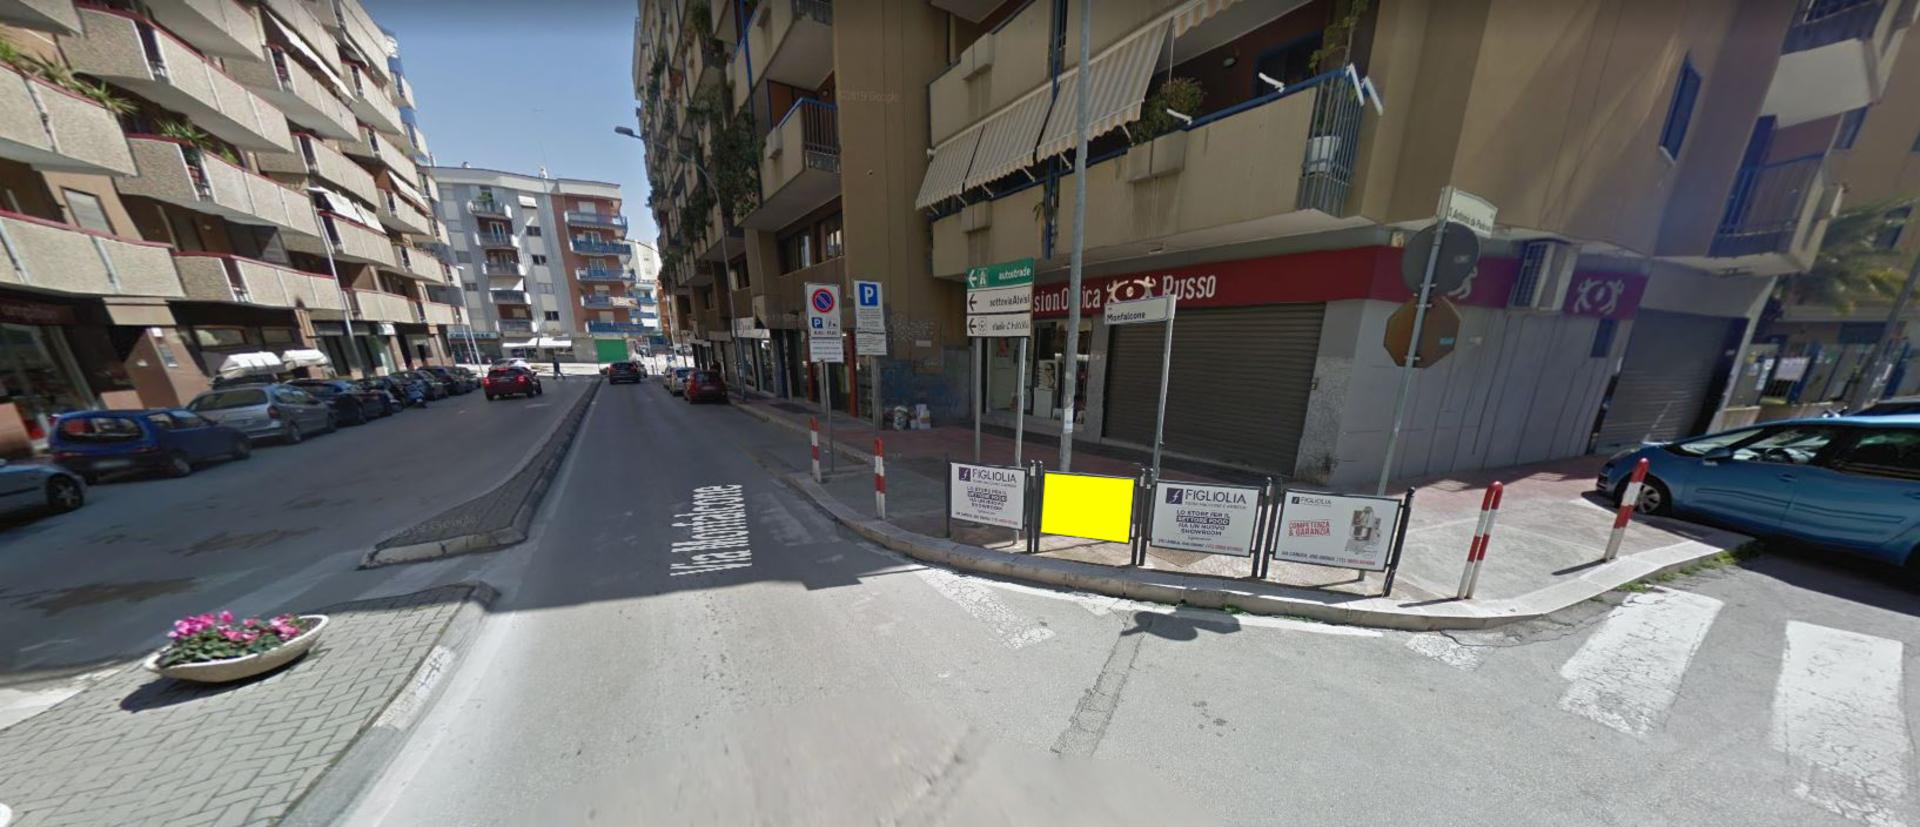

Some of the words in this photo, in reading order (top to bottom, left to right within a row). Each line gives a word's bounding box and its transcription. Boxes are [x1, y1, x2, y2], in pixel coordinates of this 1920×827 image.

[998, 267, 1031, 280] autostrade
[1106, 311, 1146, 321] Monfalcone
[972, 468, 1017, 484] FIGLIOLIA
[1184, 489, 1247, 505] FIGLIOLIA
